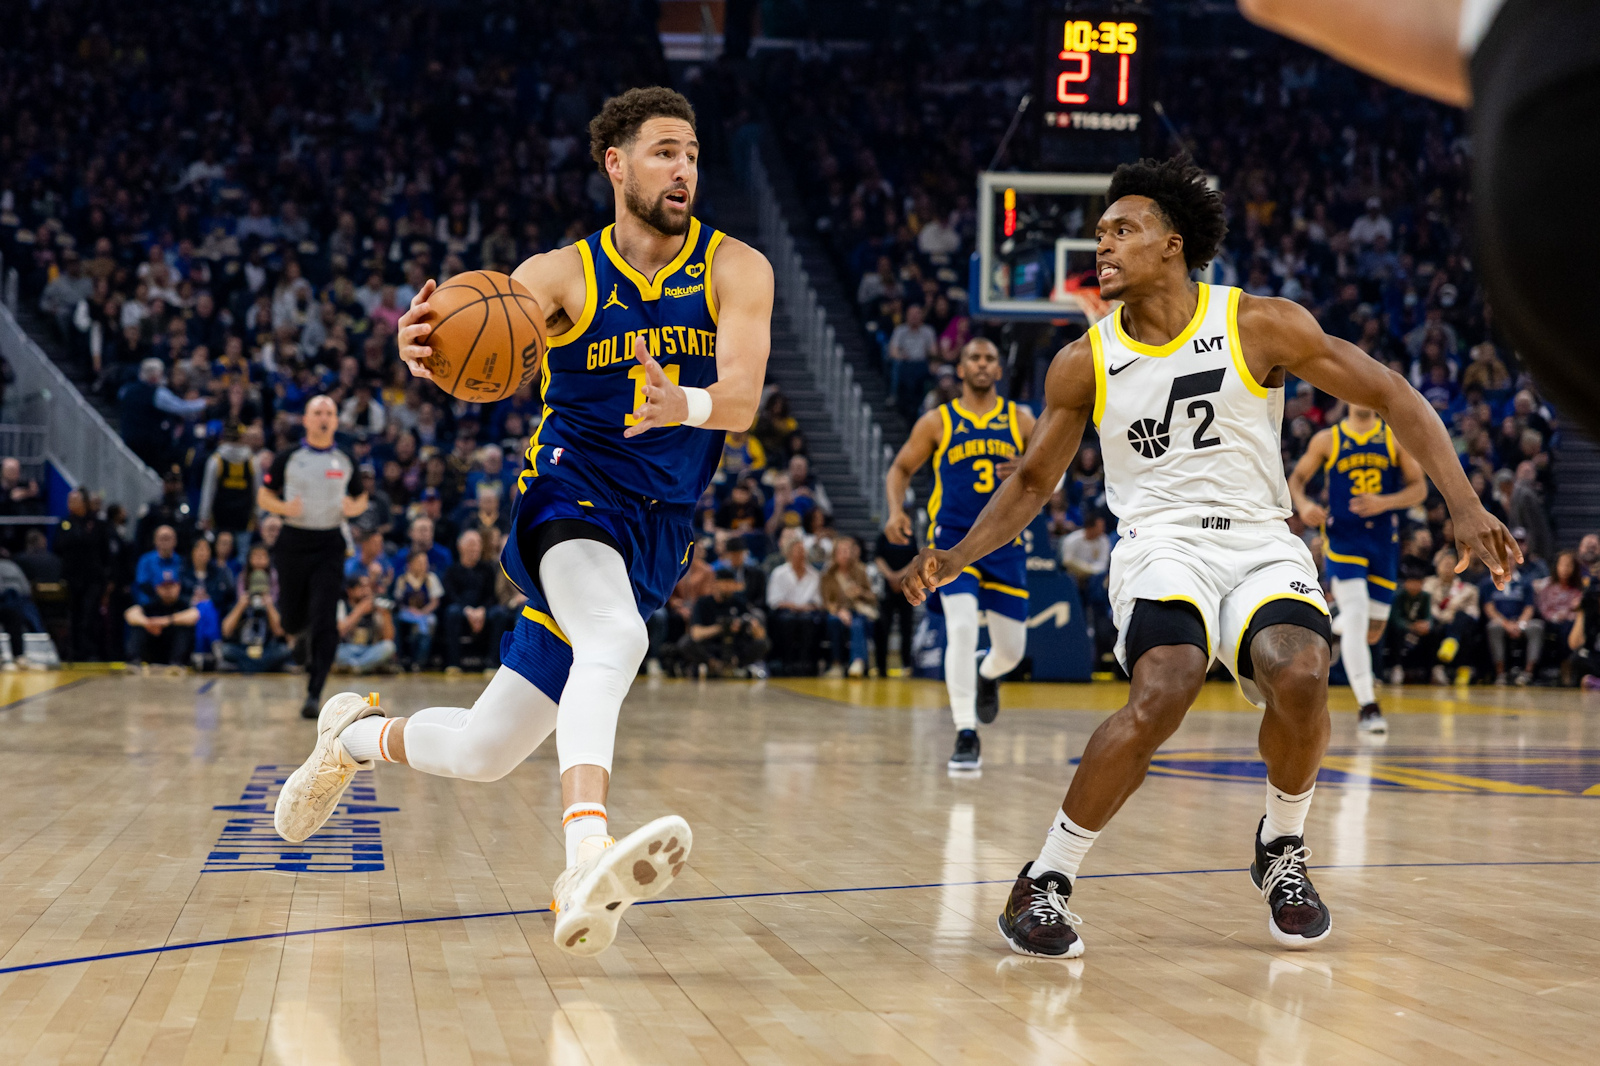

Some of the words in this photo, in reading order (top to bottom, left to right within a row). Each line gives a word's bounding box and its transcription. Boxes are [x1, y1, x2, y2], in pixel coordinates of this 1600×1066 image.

[1064, 20, 1138, 54] 10:35
[1057, 51, 1130, 106] 21
[1071, 112, 1141, 131] TISSOT
[664, 283, 704, 298] Rakuten
[661, 325, 717, 357] STATE
[1193, 335, 1224, 354] LVT
[1186, 399, 1221, 450] 2
[972, 458, 995, 493] 3
[1348, 467, 1383, 496] 32
